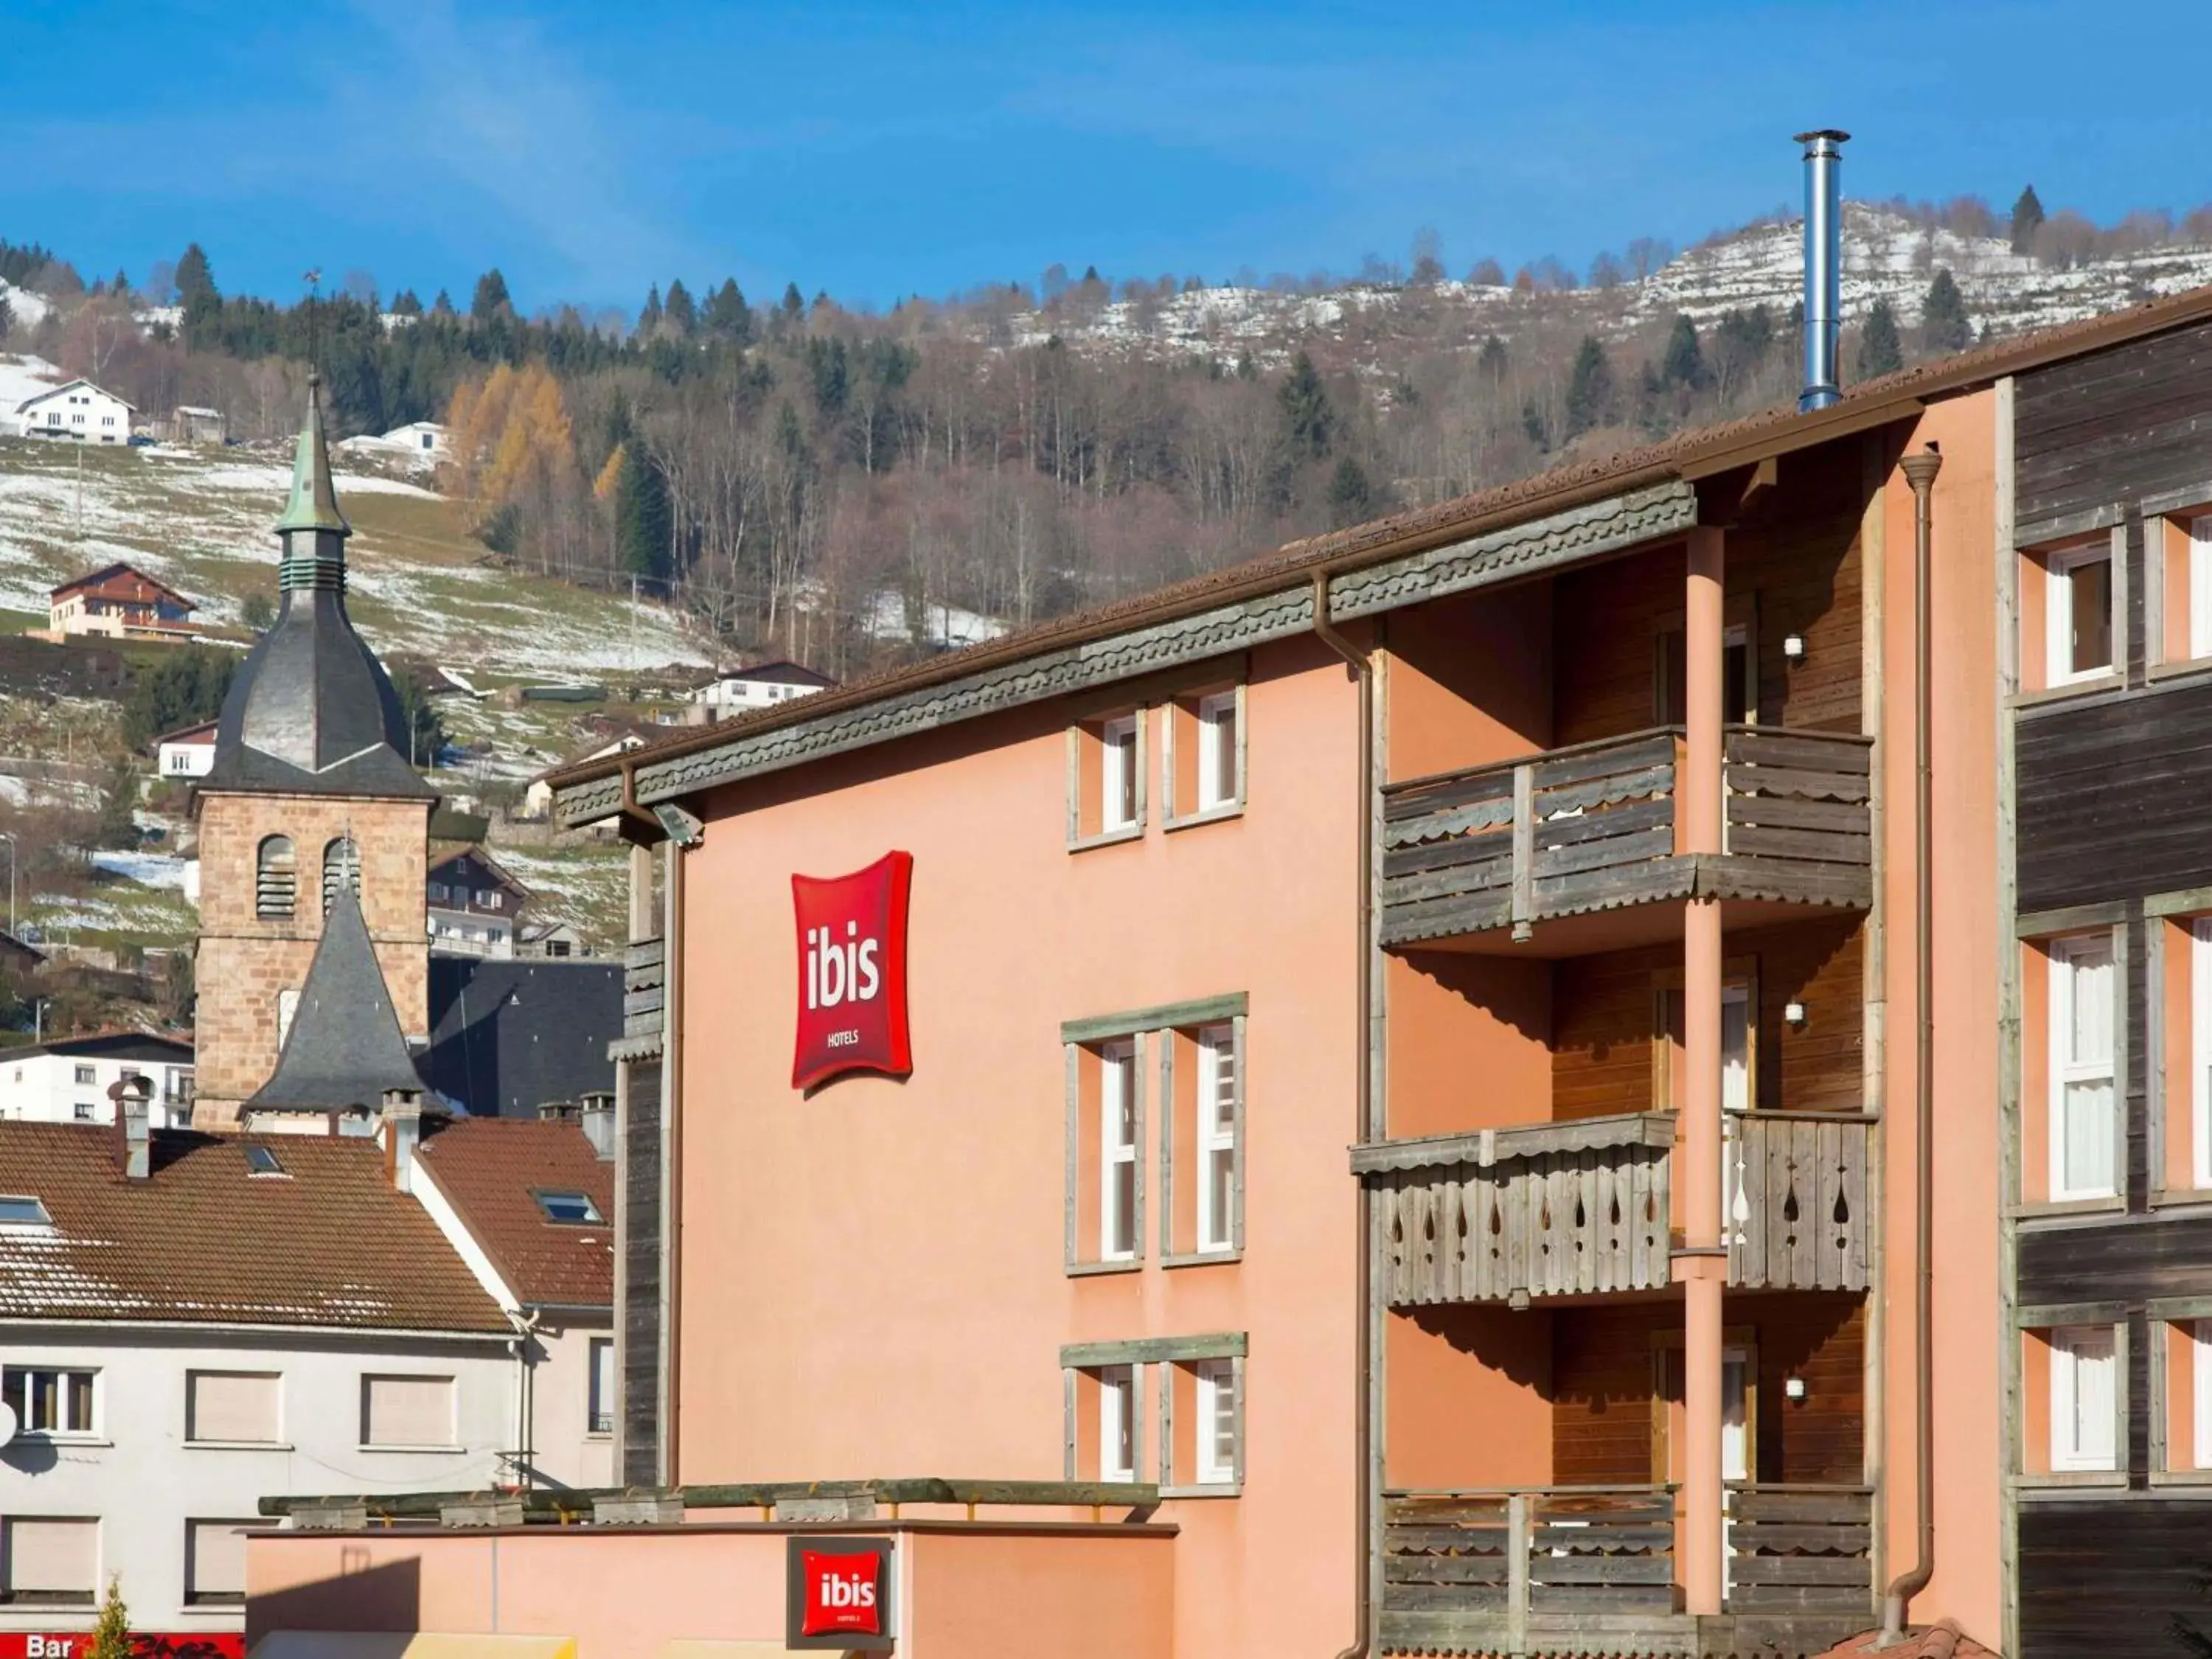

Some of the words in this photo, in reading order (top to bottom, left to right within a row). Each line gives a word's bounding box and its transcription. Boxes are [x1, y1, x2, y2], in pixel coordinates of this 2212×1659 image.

[808, 920, 879, 1009] ibis
[827, 1029, 859, 1047] HOTELS
[821, 1573, 874, 1607] ibis
[27, 1635, 72, 1658] Bar
